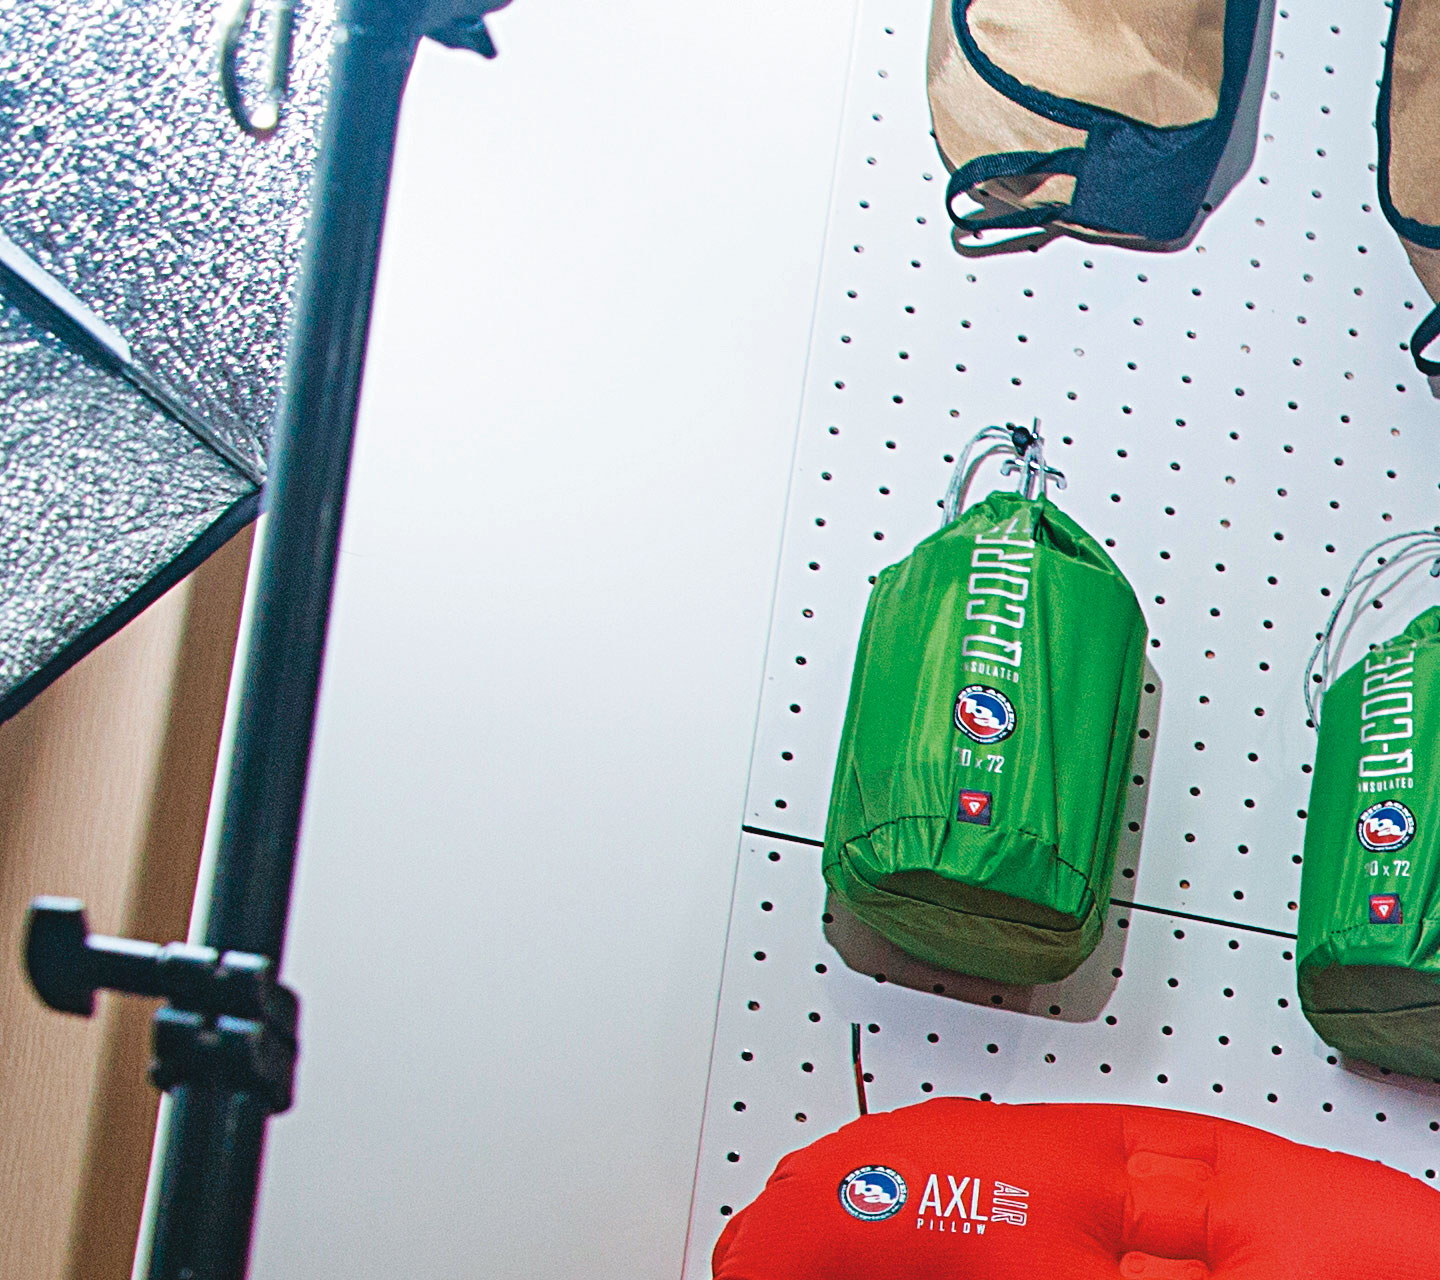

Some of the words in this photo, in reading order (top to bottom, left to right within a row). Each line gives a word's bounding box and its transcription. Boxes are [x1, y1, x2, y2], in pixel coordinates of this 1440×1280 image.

[1359, 650, 1414, 778] Q-CORE
[986, 754, 1006, 774] 72
[1358, 777, 1414, 793] INSULATED
[1392, 860, 1411, 877] 72
[918, 1174, 988, 1221] AXL
[991, 1181, 1030, 1226] AIR
[916, 1217, 986, 1235] PILLOW
